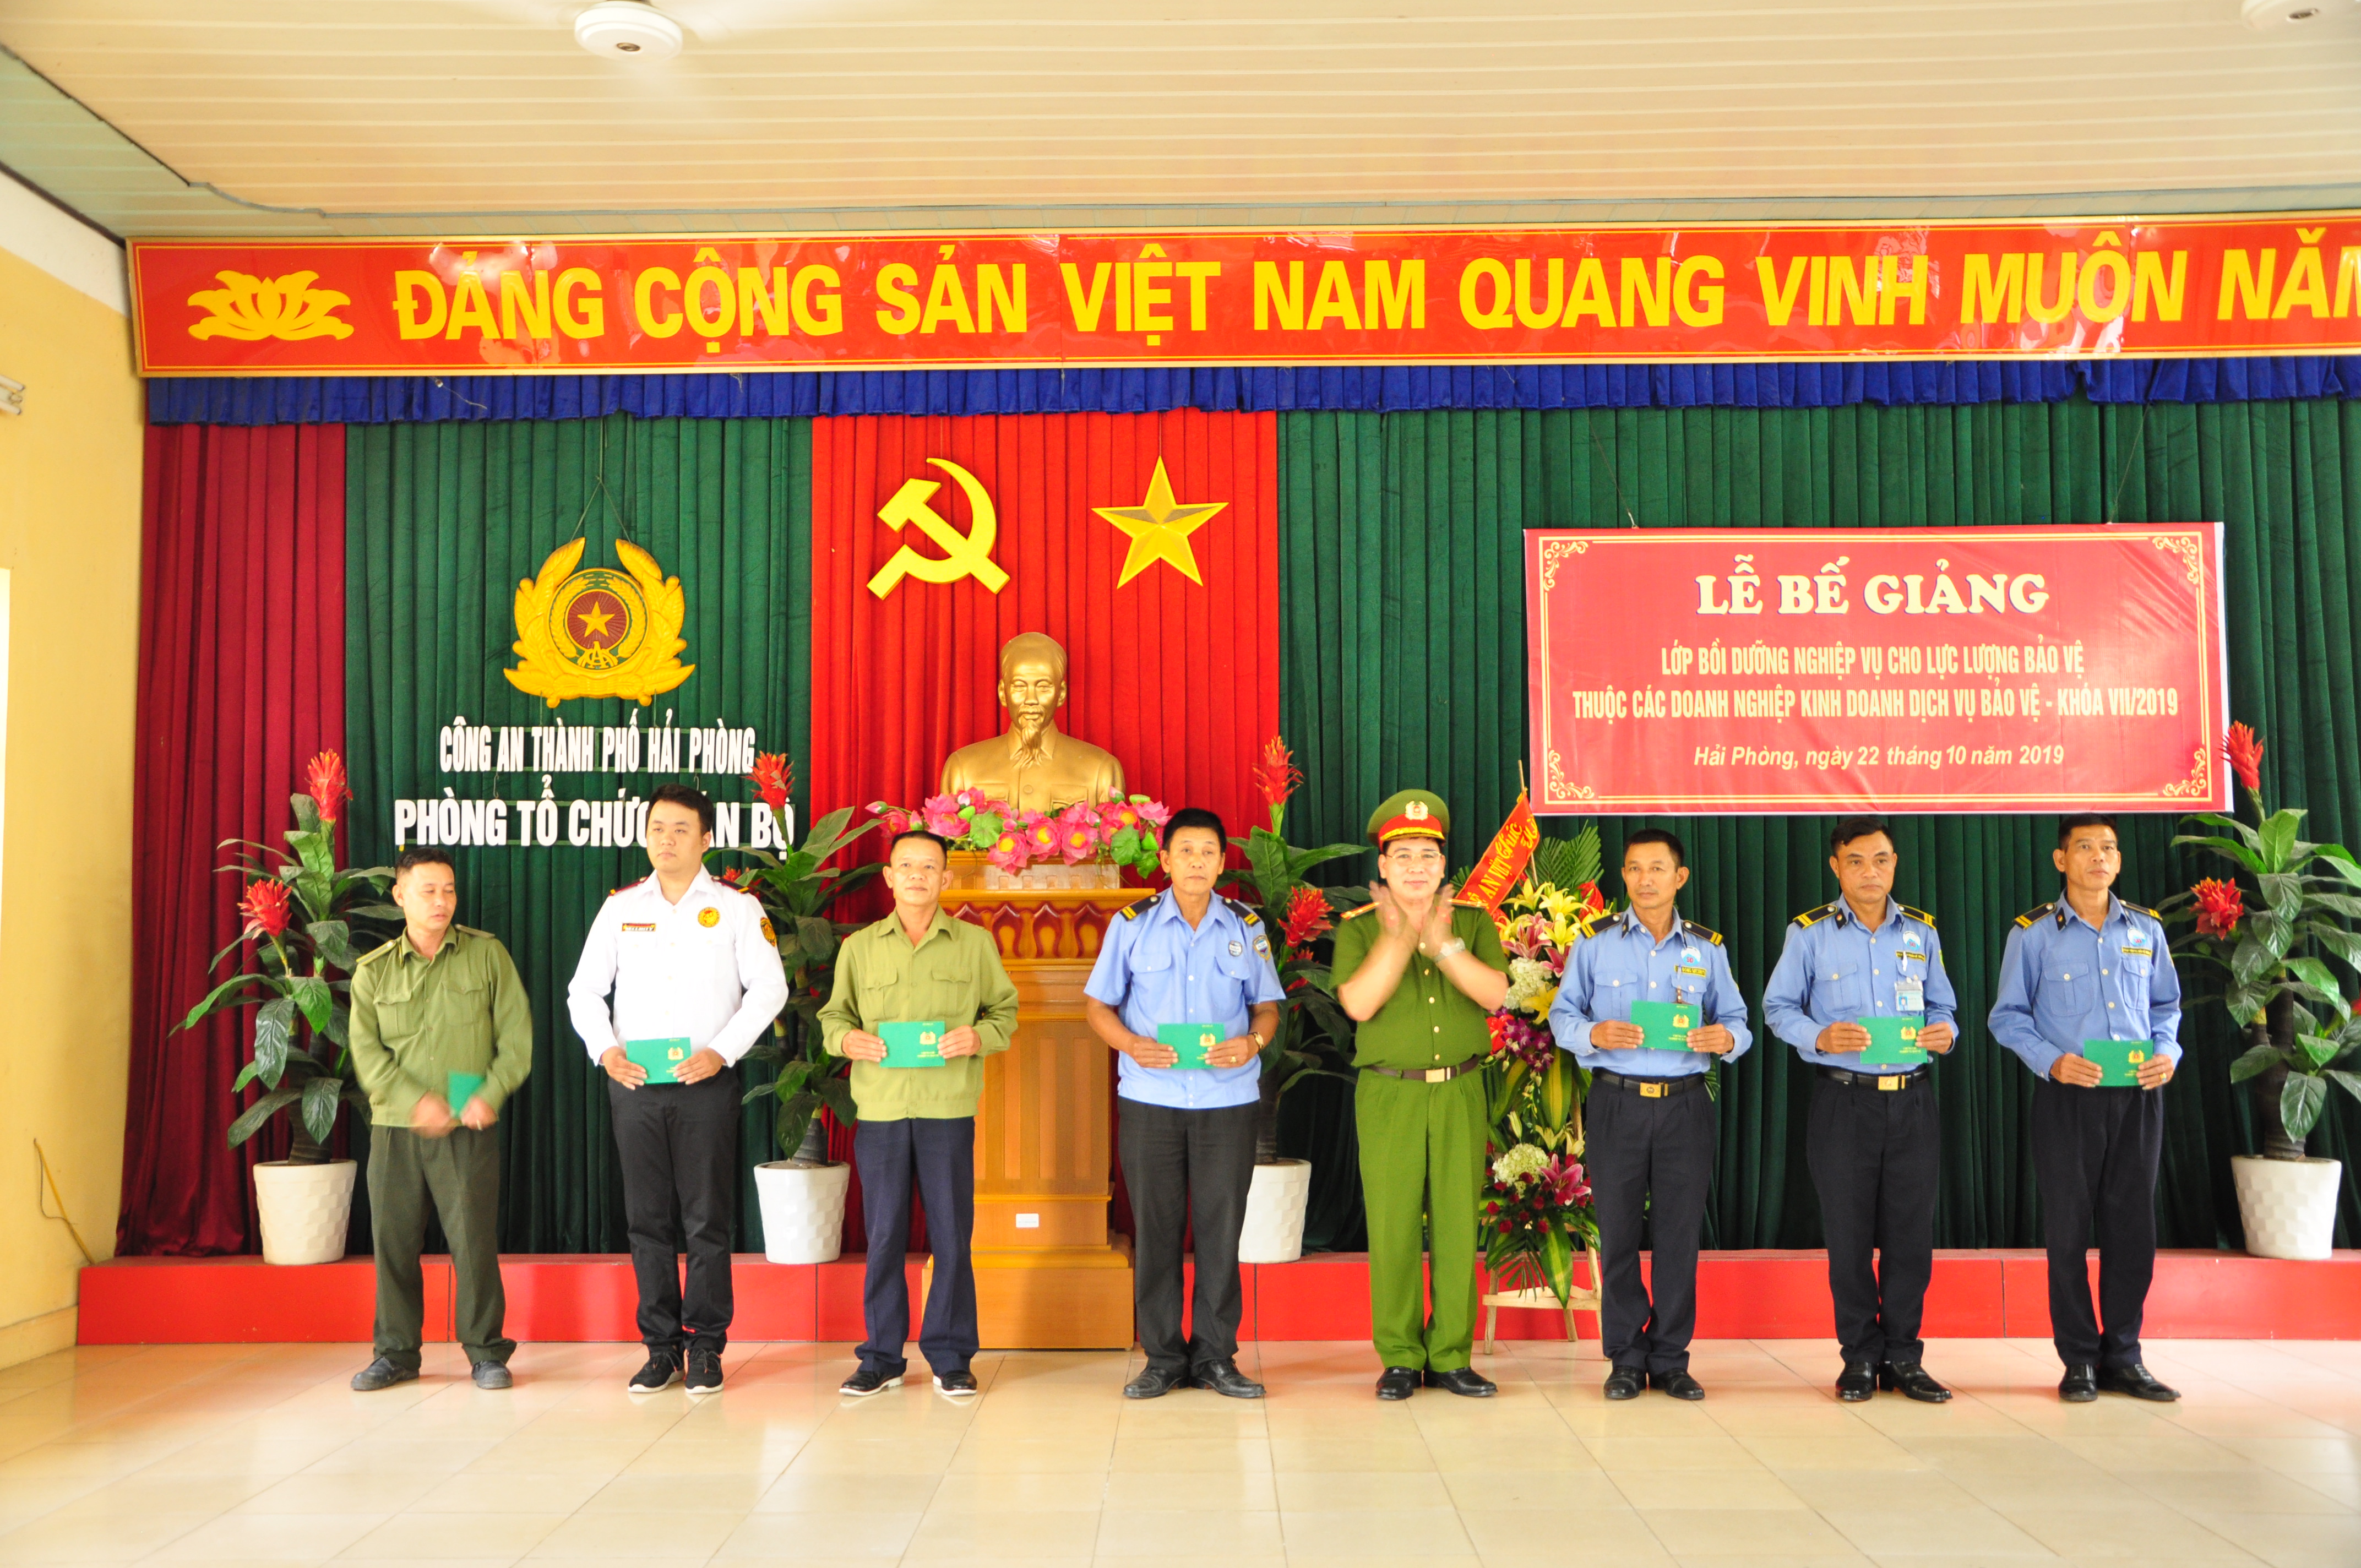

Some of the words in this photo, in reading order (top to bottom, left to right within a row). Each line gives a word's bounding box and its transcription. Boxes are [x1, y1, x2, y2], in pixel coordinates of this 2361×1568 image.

[393, 251, 605, 340] ĐẢNG
[634, 248, 843, 352] CỘNG
[876, 244, 1027, 335] SẢN
[1060, 244, 1221, 345] VIỆT
[1254, 260, 1425, 330] NAM
[1459, 255, 1724, 329] QUANG
[1755, 255, 1928, 326] VINH
[1960, 231, 2187, 325] MUÔN
[1695, 554, 1764, 616] LỄ
[1777, 555, 1851, 615] BẾ
[1864, 558, 2049, 615] GIẢNG
[1661, 639, 1693, 675] LỚP
[1698, 638, 1727, 675] BỒI
[1731, 639, 1789, 675] DƯỠNG
[1794, 641, 1856, 680] NGHIỆP
[1860, 646, 1883, 680] VỤ
[1887, 646, 1922, 674] CHO
[1926, 644, 1959, 680] LỰC
[1963, 643, 2020, 680] LƯỢNG
[2024, 634, 2059, 673] BẢO
[2063, 640, 2085, 679] VỆ
[1572, 684, 1627, 725] THUỘC
[1632, 684, 1666, 718] CÁC
[1671, 690, 1729, 718] DOANH
[1733, 683, 1796, 723] NGHIỆP
[1800, 689, 1842, 717] KINH
[1846, 689, 1905, 717] DOANH
[1909, 689, 1949, 723] DỊCH
[1953, 689, 1976, 723] VỤ
[1981, 677, 2015, 717] BẢO
[2019, 683, 2040, 722] VỆ
[2057, 683, 2104, 716] KHÓA
[2107, 688, 2178, 716] VII/2019
[440, 716, 491, 772] CÔNG
[496, 726, 524, 772] AN
[531, 717, 594, 772] THÀNH
[602, 709, 640, 772] PHỐ
[648, 709, 680, 773] HẢI
[689, 718, 755, 774] PHÒNG
[1694, 744, 1726, 766] Hải
[1731, 745, 1798, 770] Phòng,
[1805, 745, 1854, 770] ngày
[1857, 745, 1880, 765] 22
[1887, 745, 1942, 770] tháng
[1946, 745, 1967, 765] 10
[1971, 745, 2012, 765] năm
[2019, 745, 2064, 765] 2019
[395, 787, 507, 846] PHÒNG
[516, 775, 558, 846] TỔ
[1478, 874, 1502, 900] AN
[1488, 856, 1513, 880] VIỆT
